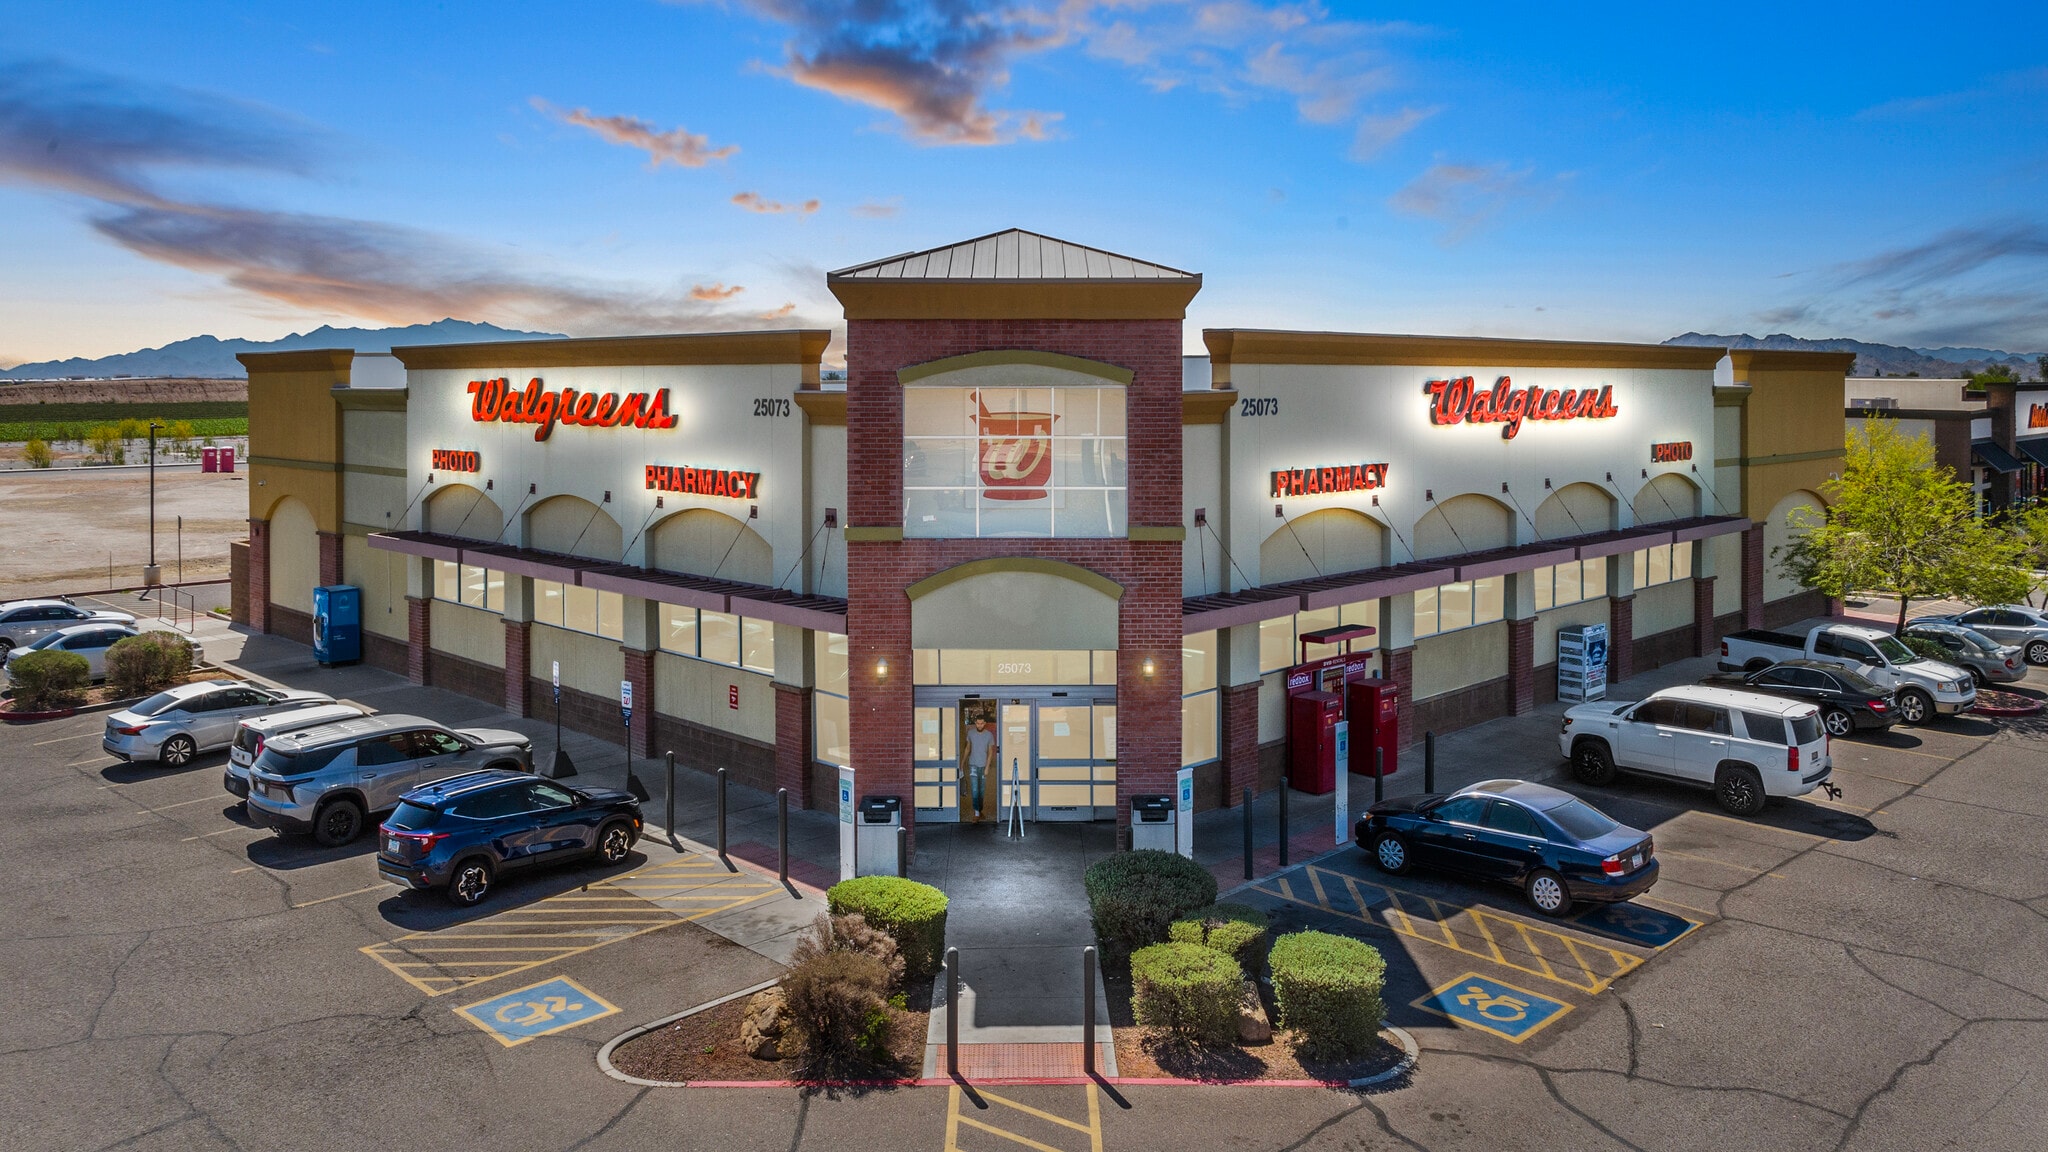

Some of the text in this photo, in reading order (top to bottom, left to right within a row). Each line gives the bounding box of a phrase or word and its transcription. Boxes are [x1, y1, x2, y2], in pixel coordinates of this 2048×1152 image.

[467, 376, 678, 442] Walgreens
[753, 398, 790, 418] 25073
[1241, 397, 1278, 417] 25073
[1424, 375, 1619, 440] Walgreens
[432, 449, 480, 473] PHOTO
[1652, 441, 1693, 463] PHOTO
[645, 465, 760, 499] PHARMACY
[1272, 463, 1390, 498] PHARMACY
[997, 662, 1032, 675] 25073
[1345, 662, 1364, 673] redbox
[1289, 674, 1310, 687] redbox
